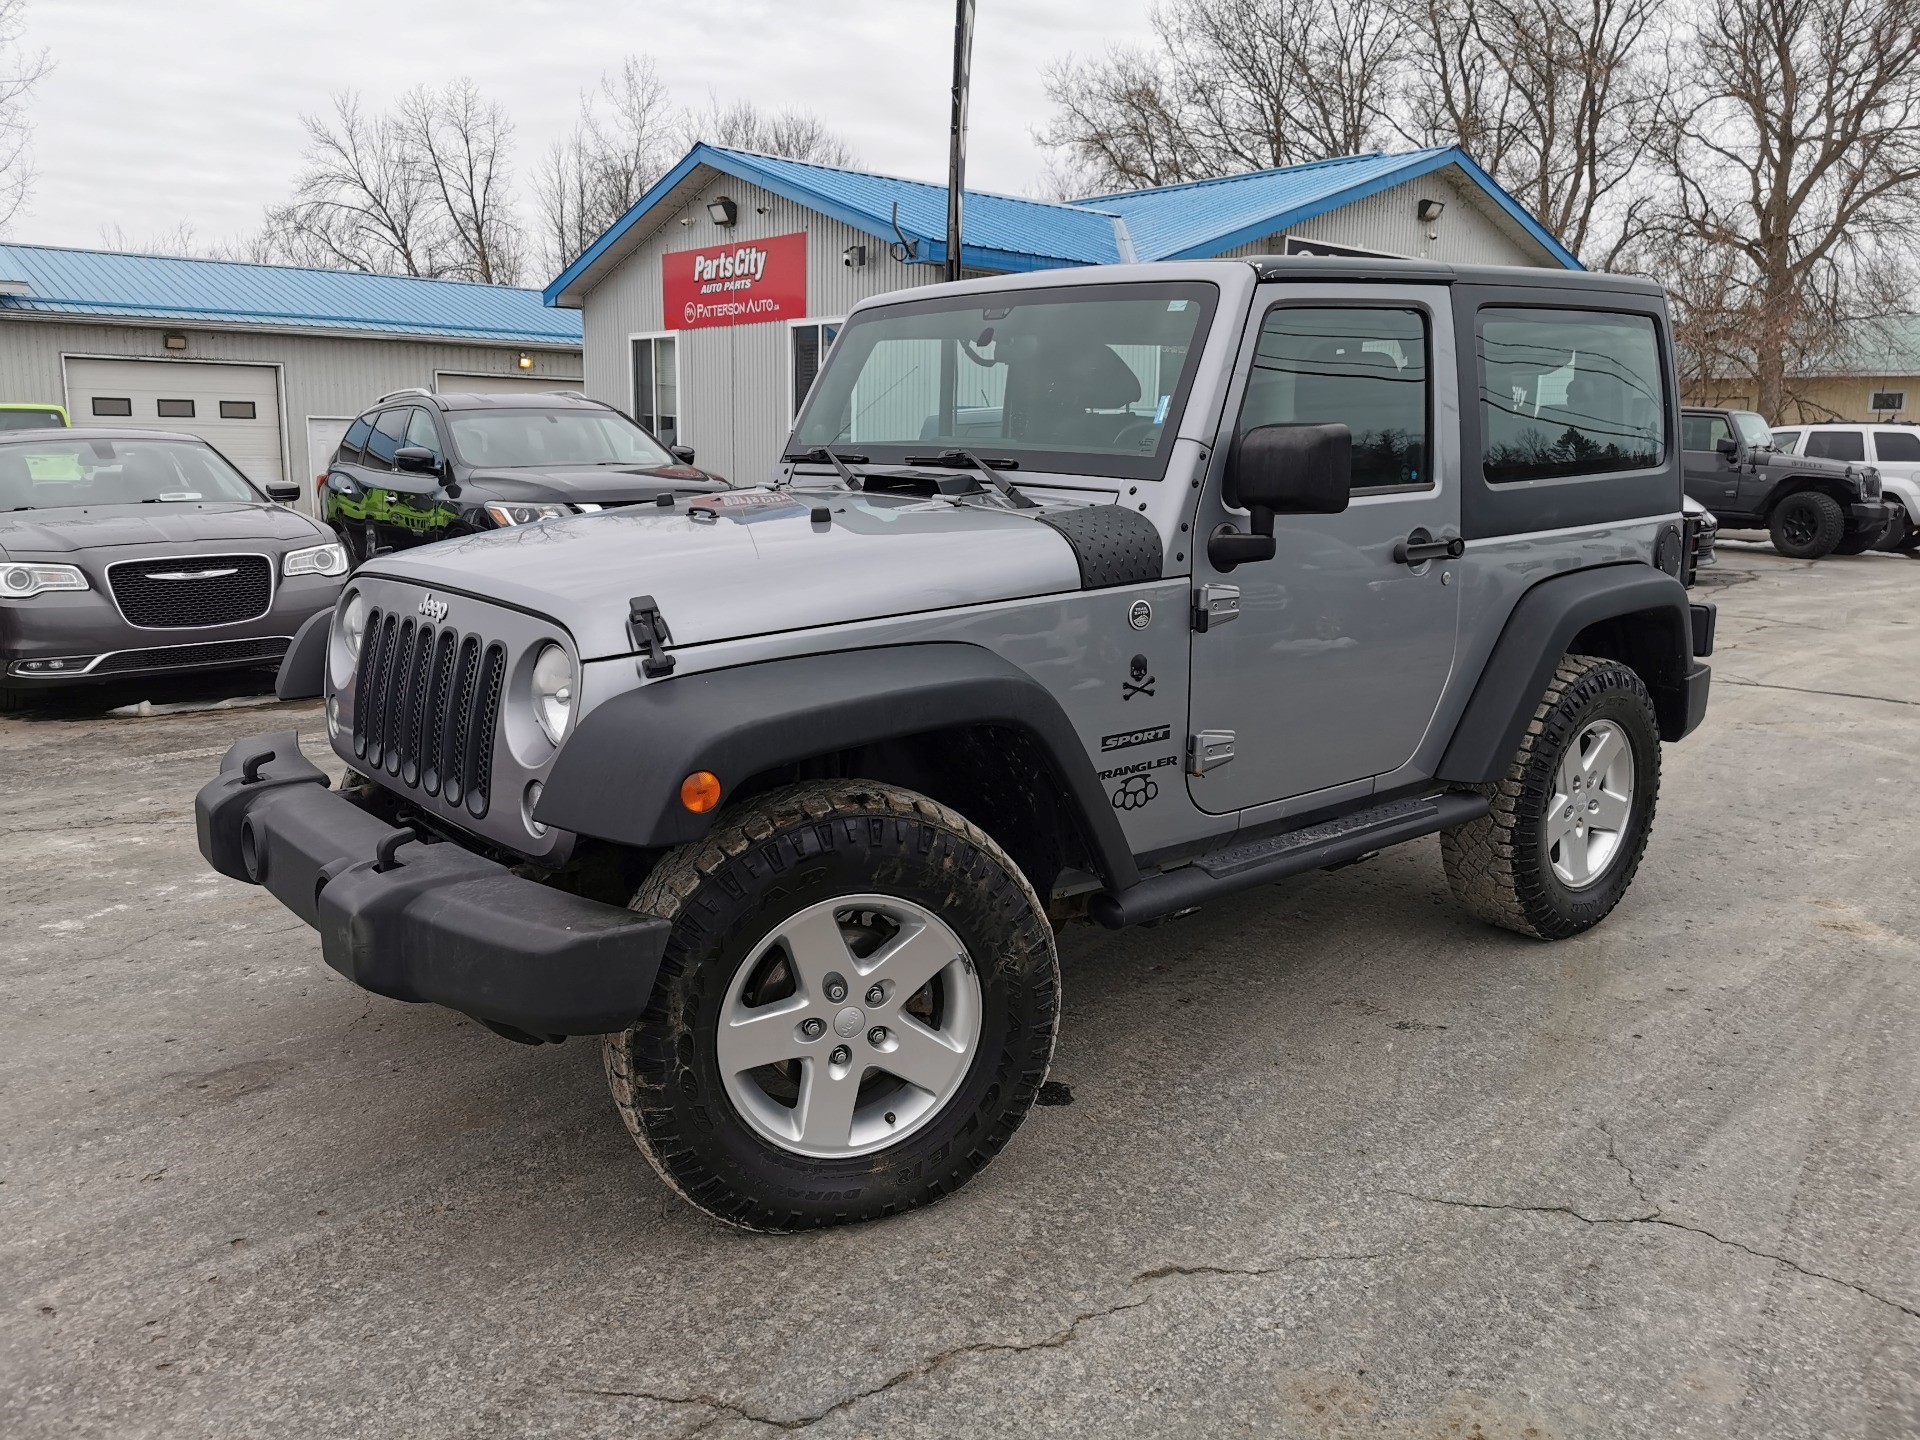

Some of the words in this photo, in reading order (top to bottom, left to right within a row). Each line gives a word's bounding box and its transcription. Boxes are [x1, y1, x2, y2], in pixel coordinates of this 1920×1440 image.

[694, 247, 767, 282] PartsCity
[700, 283, 722, 294] AUTO
[724, 279, 751, 291] PARTS
[697, 302, 745, 318] PATTERSON
[419, 593, 448, 623] Jeep
[1102, 729, 1170, 749] SPORT
[841, 1010, 858, 1035] Jeep
